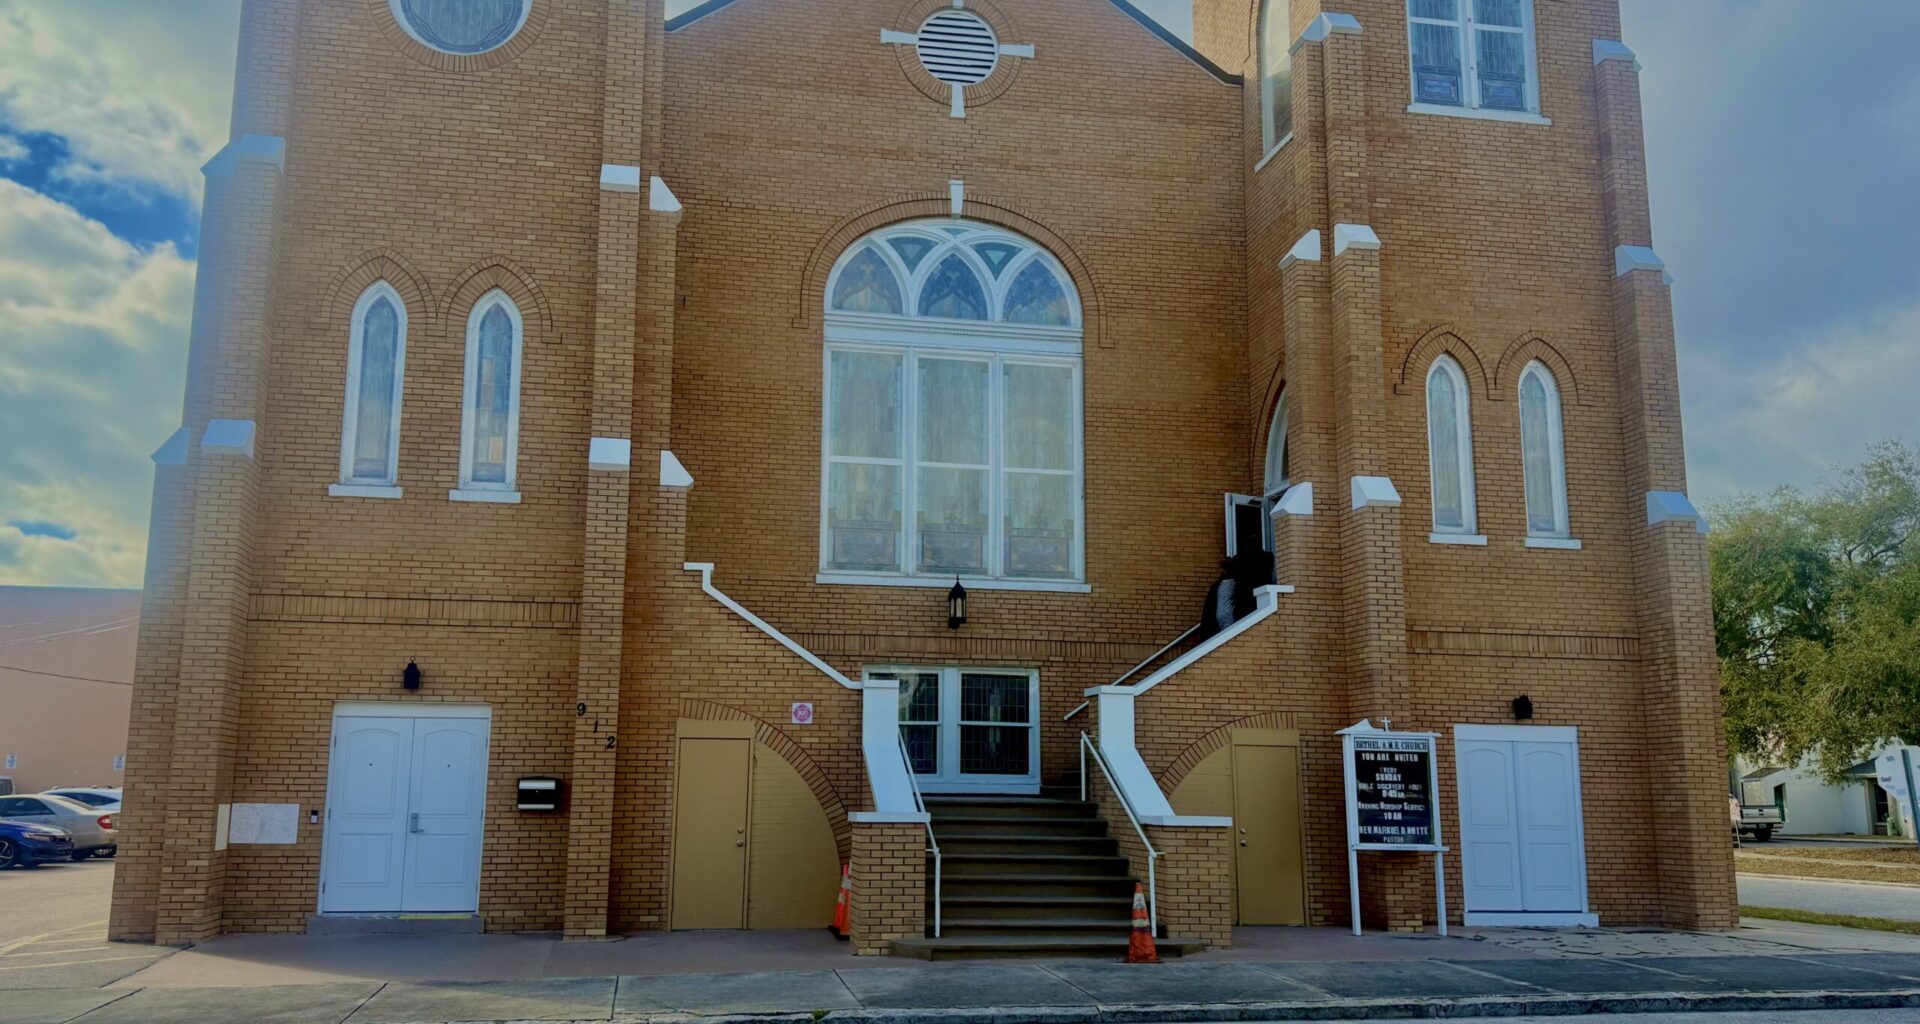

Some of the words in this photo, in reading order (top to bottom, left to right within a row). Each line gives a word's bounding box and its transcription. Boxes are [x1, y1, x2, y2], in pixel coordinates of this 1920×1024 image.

[1355, 740, 1380, 749] BETHEL
[1401, 741, 1427, 751] CHURCH
[1362, 752, 1375, 760] YOU
[1377, 753, 1390, 761] ARE
[1375, 773, 1402, 781] SUNDAY
[1383, 812, 1392, 820] 10
[1393, 812, 1402, 820] AM
[1407, 826, 1429, 835] WHITE
